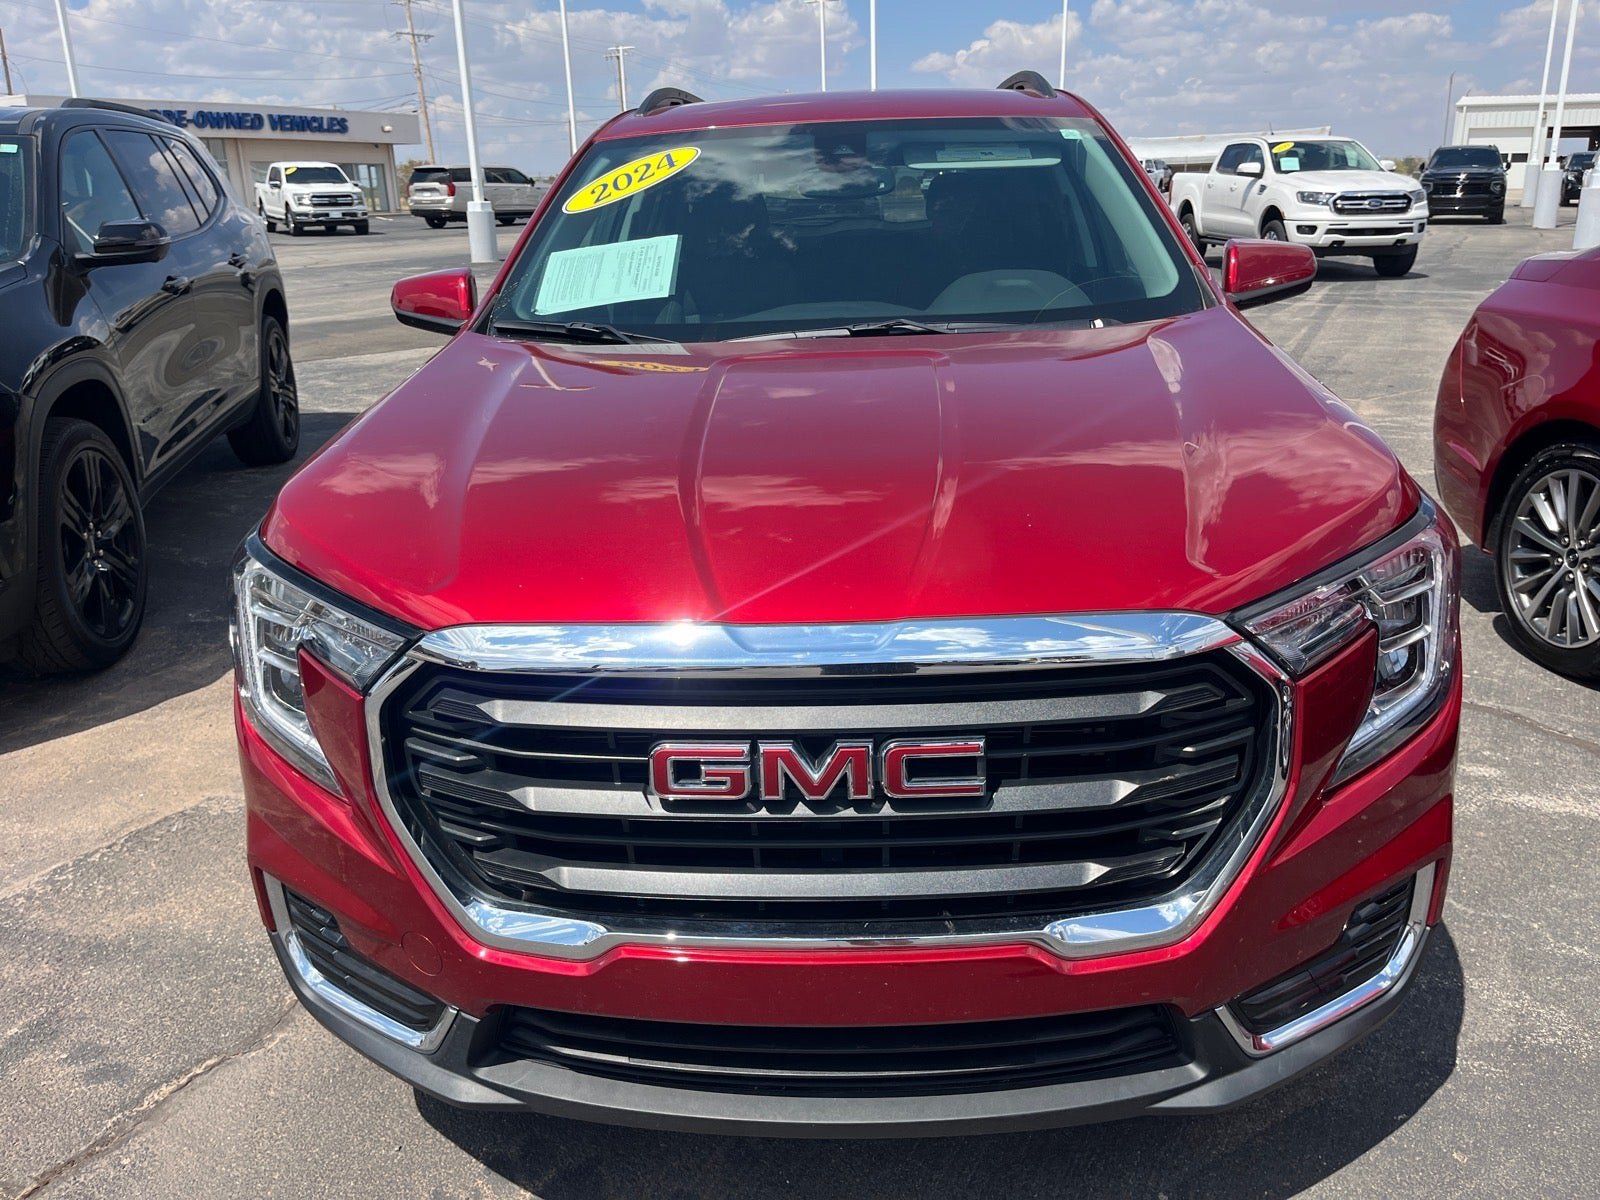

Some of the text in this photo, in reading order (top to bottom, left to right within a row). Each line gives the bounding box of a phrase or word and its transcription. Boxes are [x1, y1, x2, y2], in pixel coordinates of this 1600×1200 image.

[149, 109, 349, 134] RE-OWNED VEHICLES
[590, 153, 679, 204] 2024
[649, 735, 986, 801] GMC
